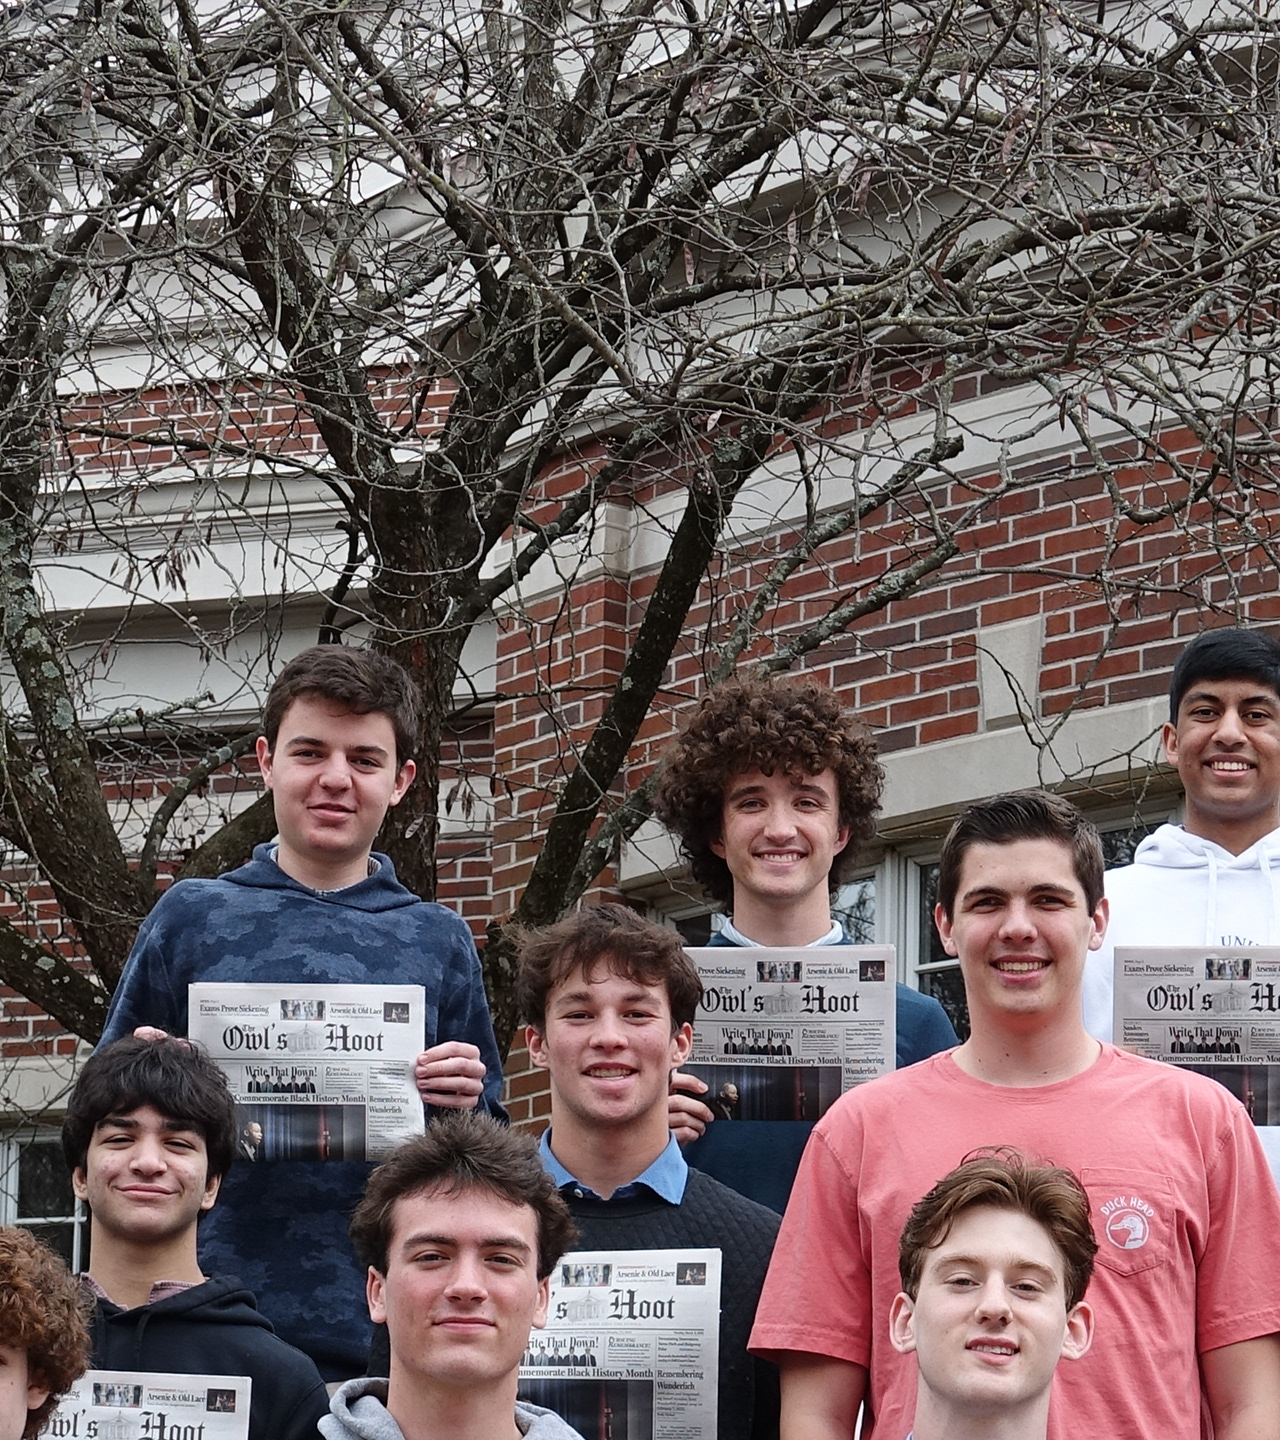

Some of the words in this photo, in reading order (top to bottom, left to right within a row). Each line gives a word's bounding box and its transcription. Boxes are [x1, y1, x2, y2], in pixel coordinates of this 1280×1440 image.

[799, 984, 860, 1014] Hoot
[323, 1023, 384, 1053] Hoot
[1100, 1196, 1128, 1216] DUCK
[1130, 1196, 1155, 1218] HEAD
[606, 1288, 676, 1321] Hoot
[50, 1408, 99, 1440] wl's
